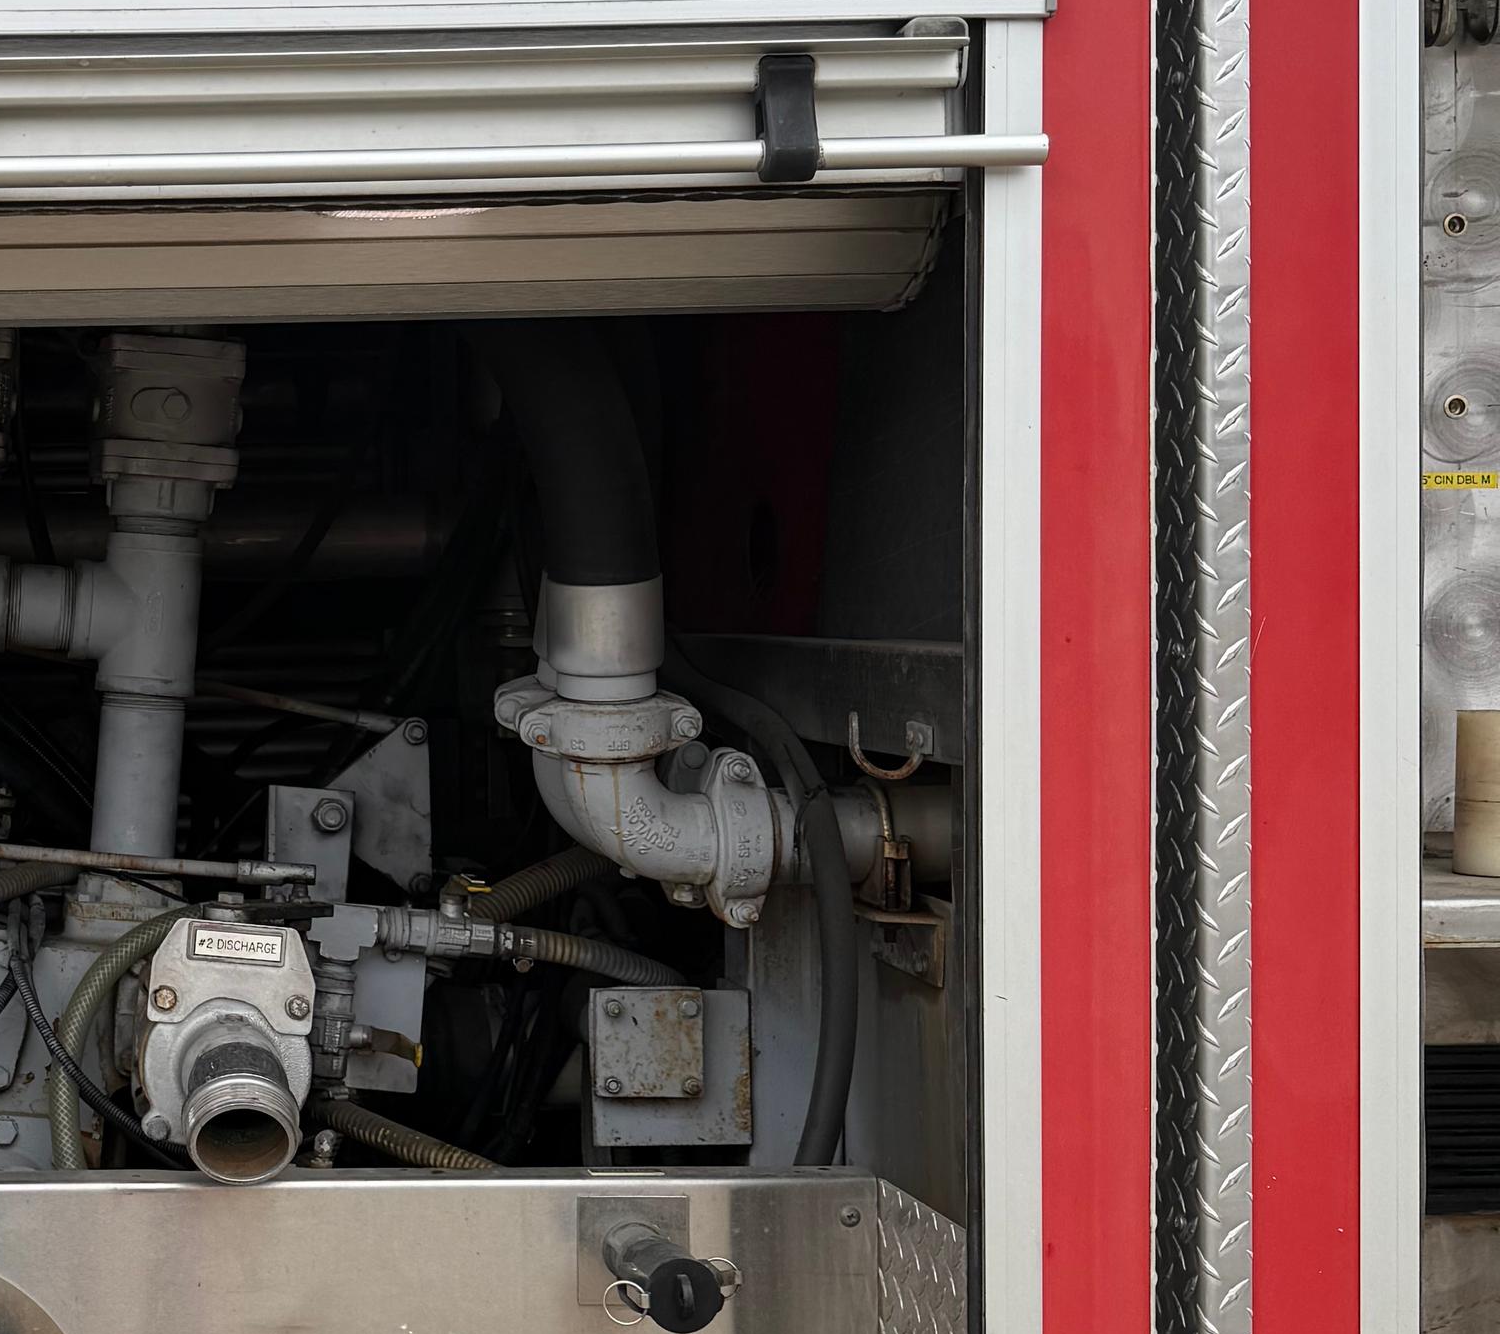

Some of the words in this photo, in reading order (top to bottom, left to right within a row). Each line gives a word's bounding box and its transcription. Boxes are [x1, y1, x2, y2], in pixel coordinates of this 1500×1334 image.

[1457, 475, 1478, 484] DBL
[1481, 475, 1491, 484] M
[217, 938, 278, 955] DISCHARGE
